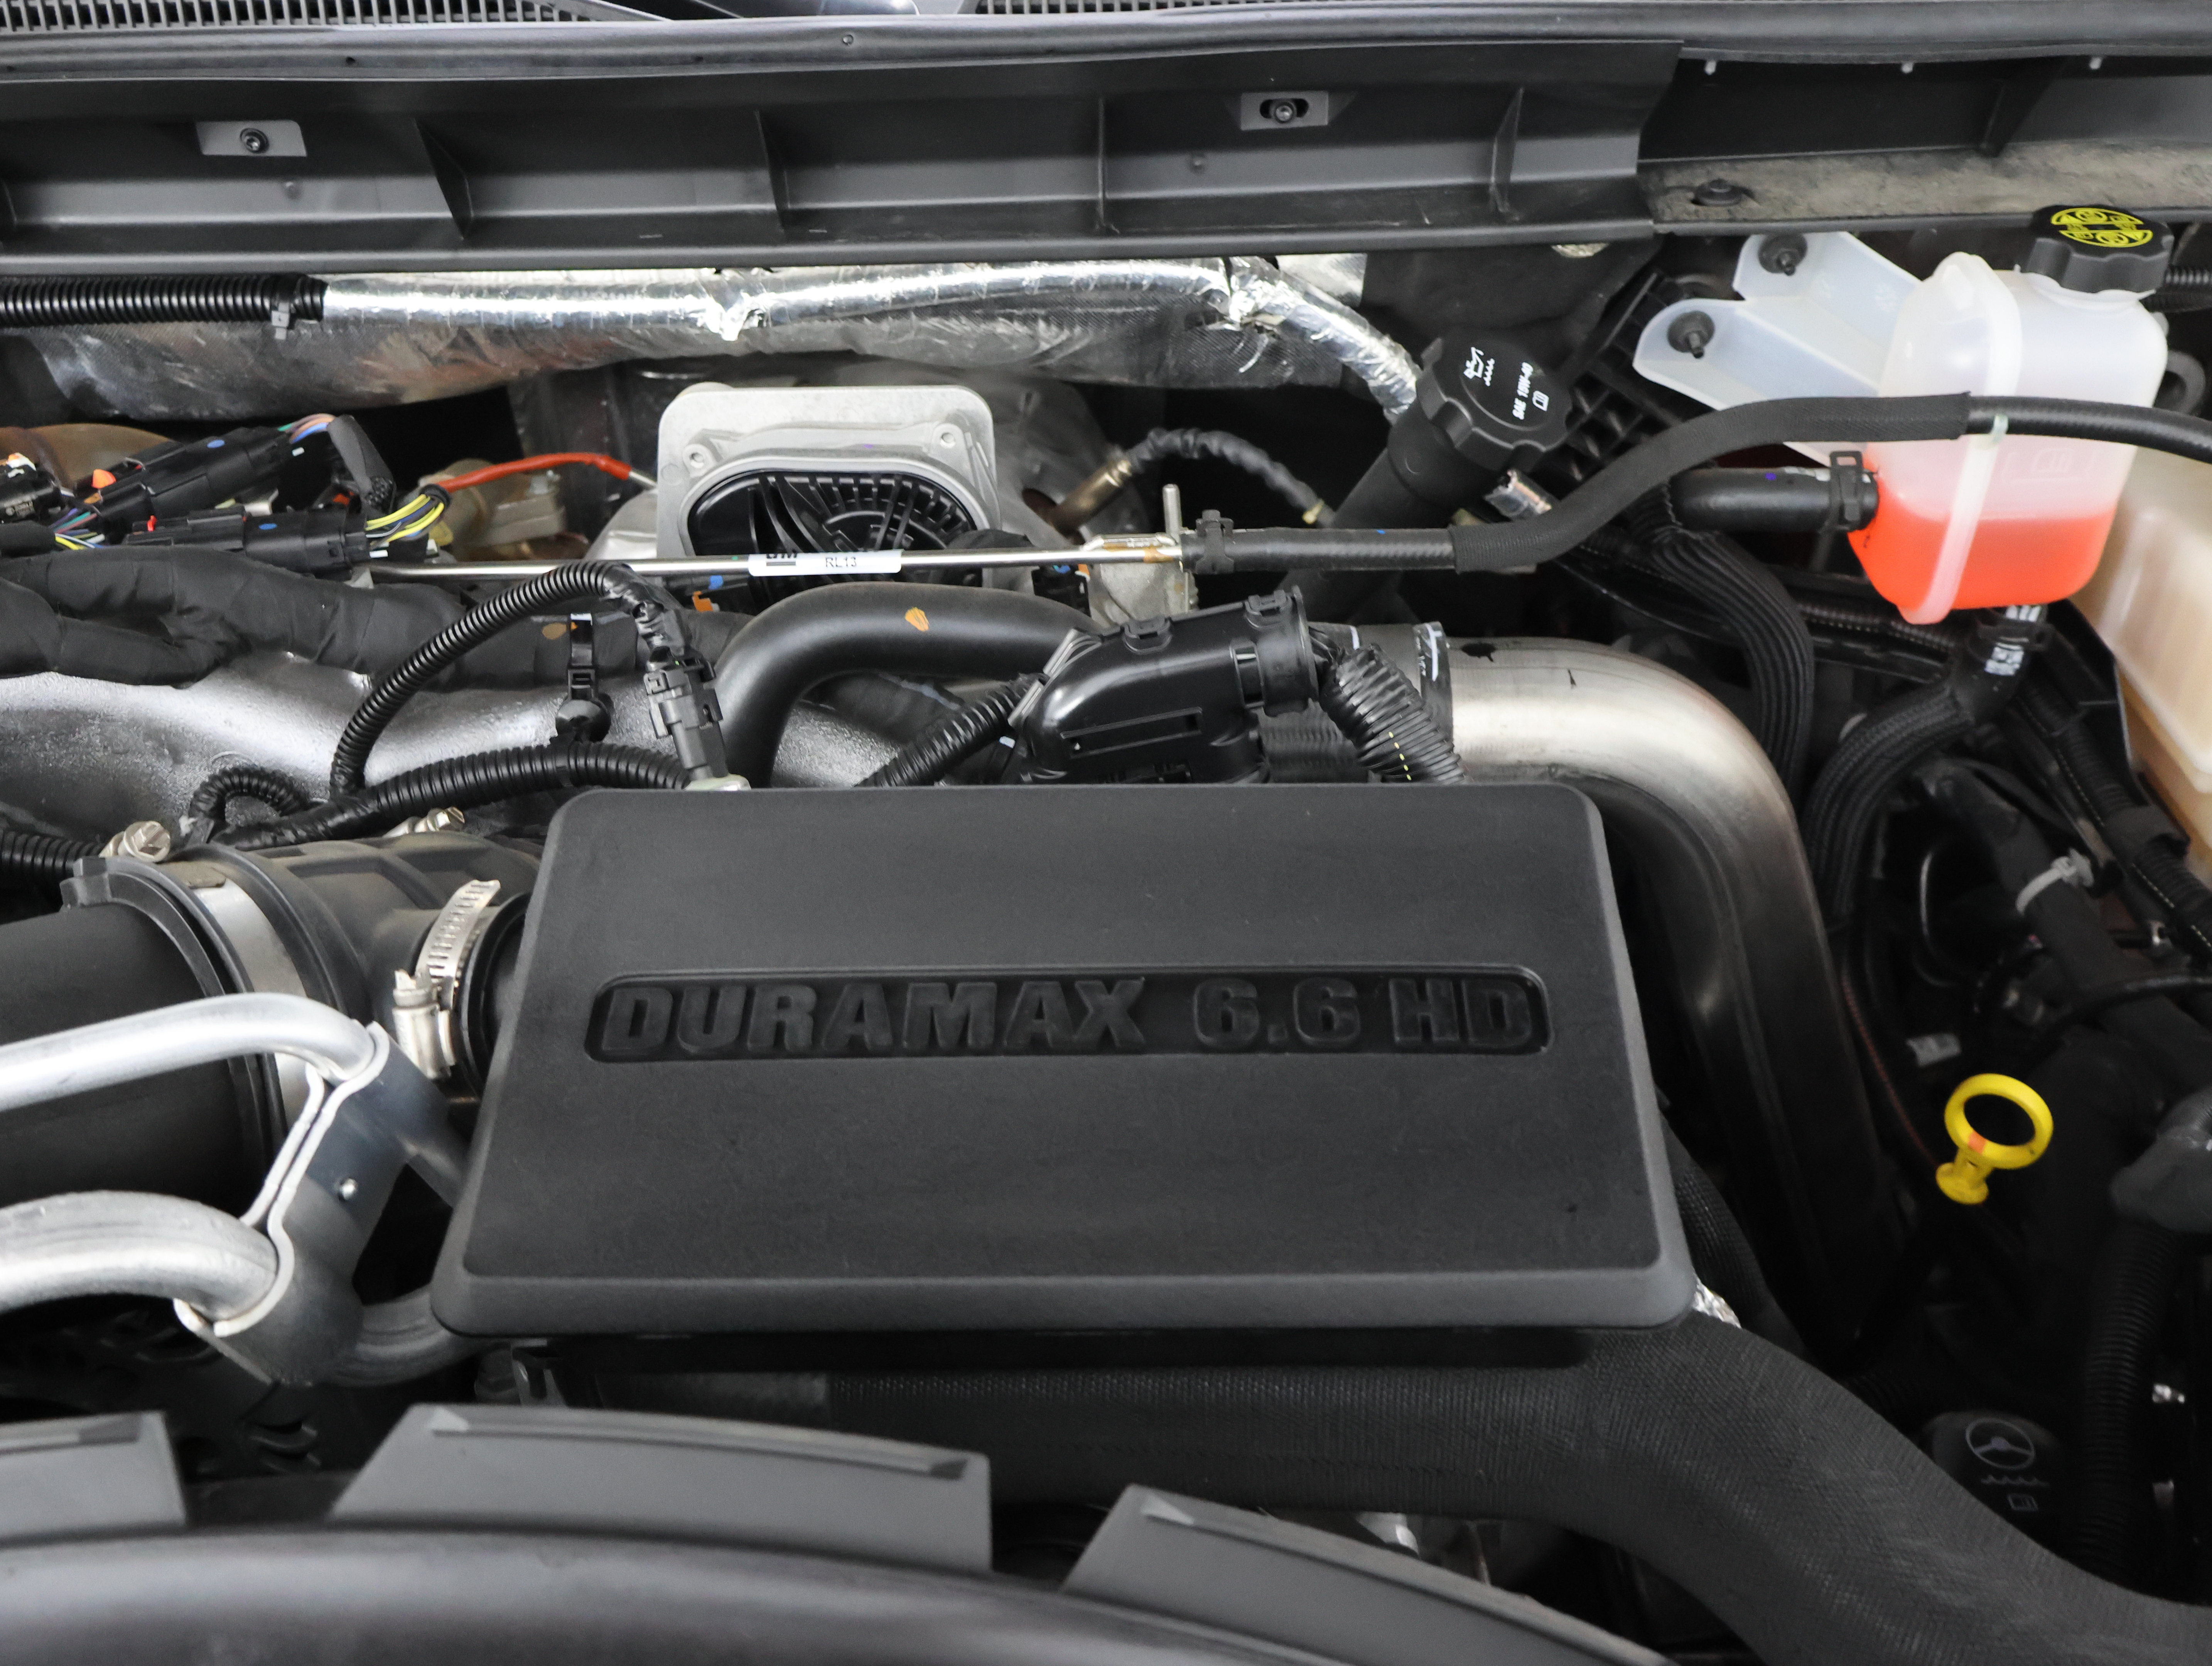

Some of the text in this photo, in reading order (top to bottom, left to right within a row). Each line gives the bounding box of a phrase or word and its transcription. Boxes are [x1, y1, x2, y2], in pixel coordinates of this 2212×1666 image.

[1512, 398, 1527, 420] SAE
[825, 556, 857, 568] RL13
[600, 977, 1533, 1054] DURAMAX 6.6 HD
